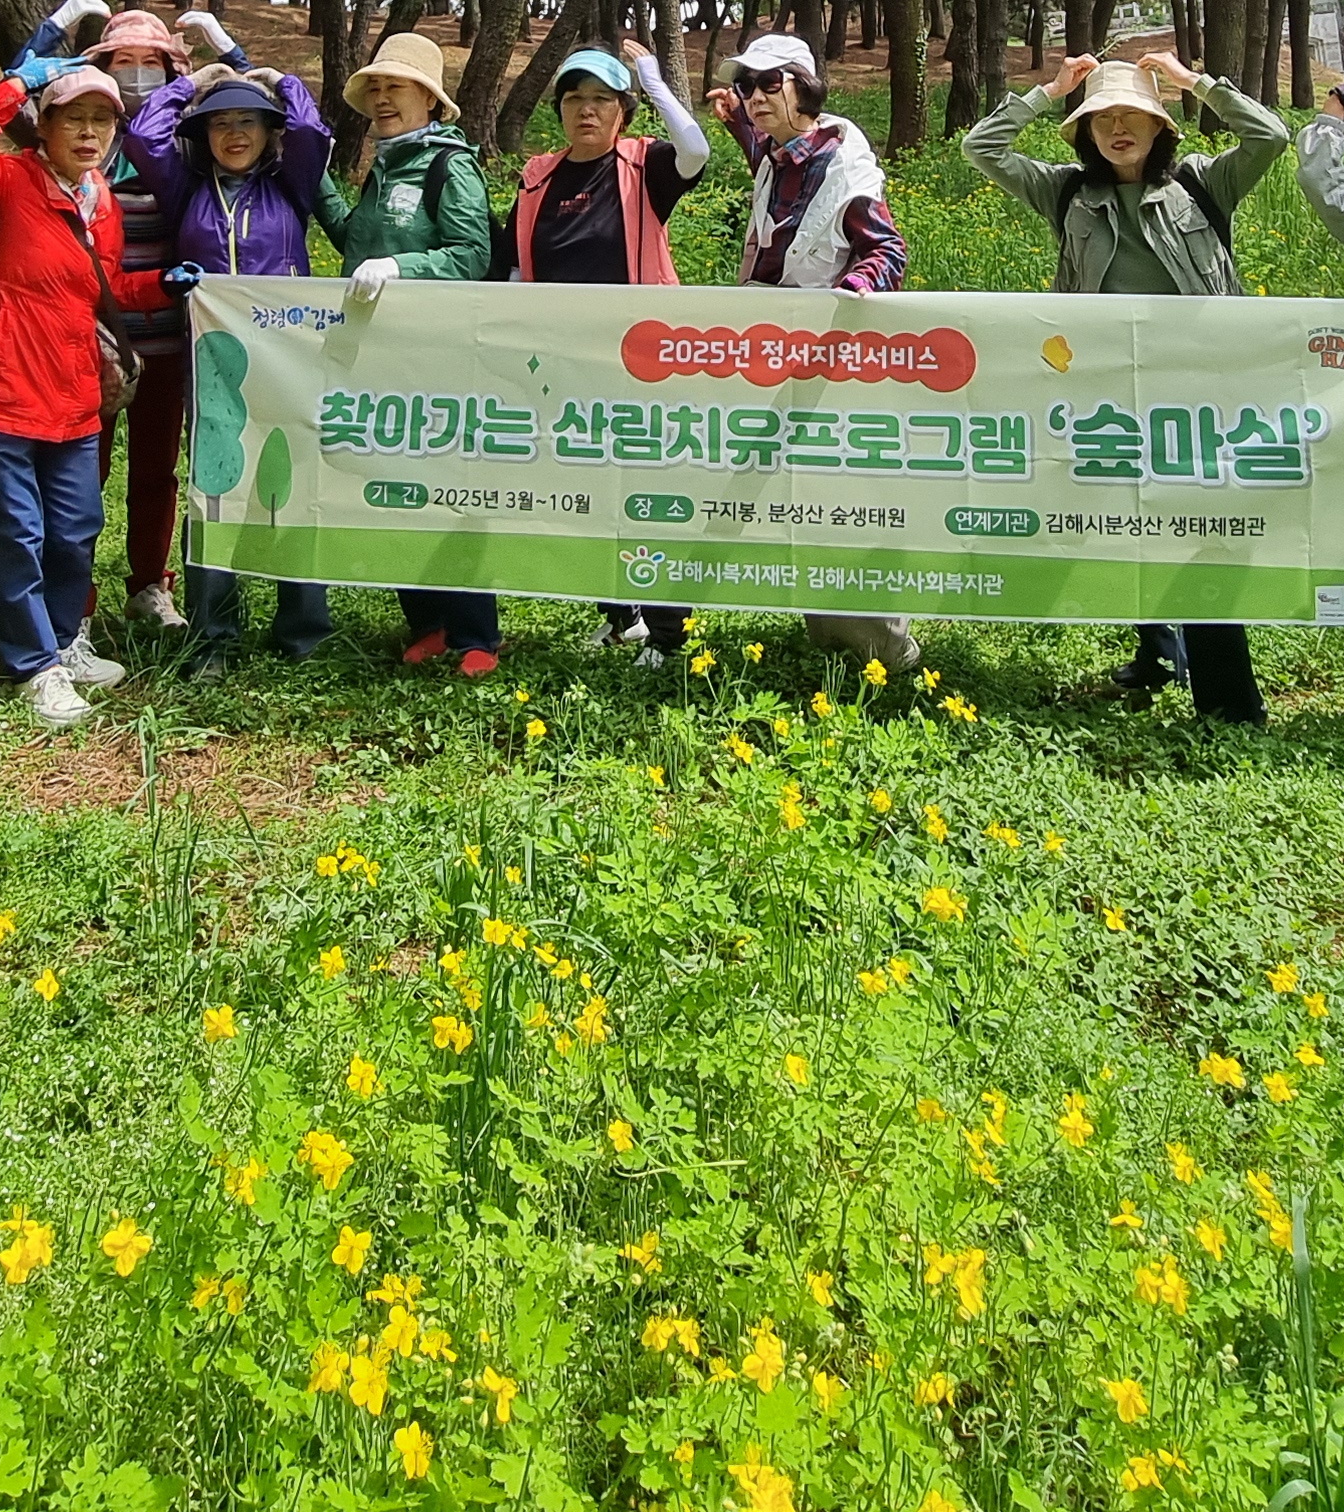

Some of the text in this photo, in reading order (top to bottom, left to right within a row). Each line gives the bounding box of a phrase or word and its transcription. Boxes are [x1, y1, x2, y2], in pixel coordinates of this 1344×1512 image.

[658, 338, 939, 372] 2025년 정서지원서비스
[318, 390, 536, 457] 찾아가는
[552, 400, 1028, 476] 산림치유프로그램
[432, 487, 501, 511] 2025년
[505, 490, 592, 516] 3월~10월
[699, 499, 763, 525] 구지봉,
[767, 502, 825, 526] 분성산
[829, 504, 907, 529] 숲생태원
[953, 509, 1268, 540] 연계기관 김해시분성산 생태체험관
[664, 559, 1006, 598] 김해시복지재단 김해시구산사회복지관
